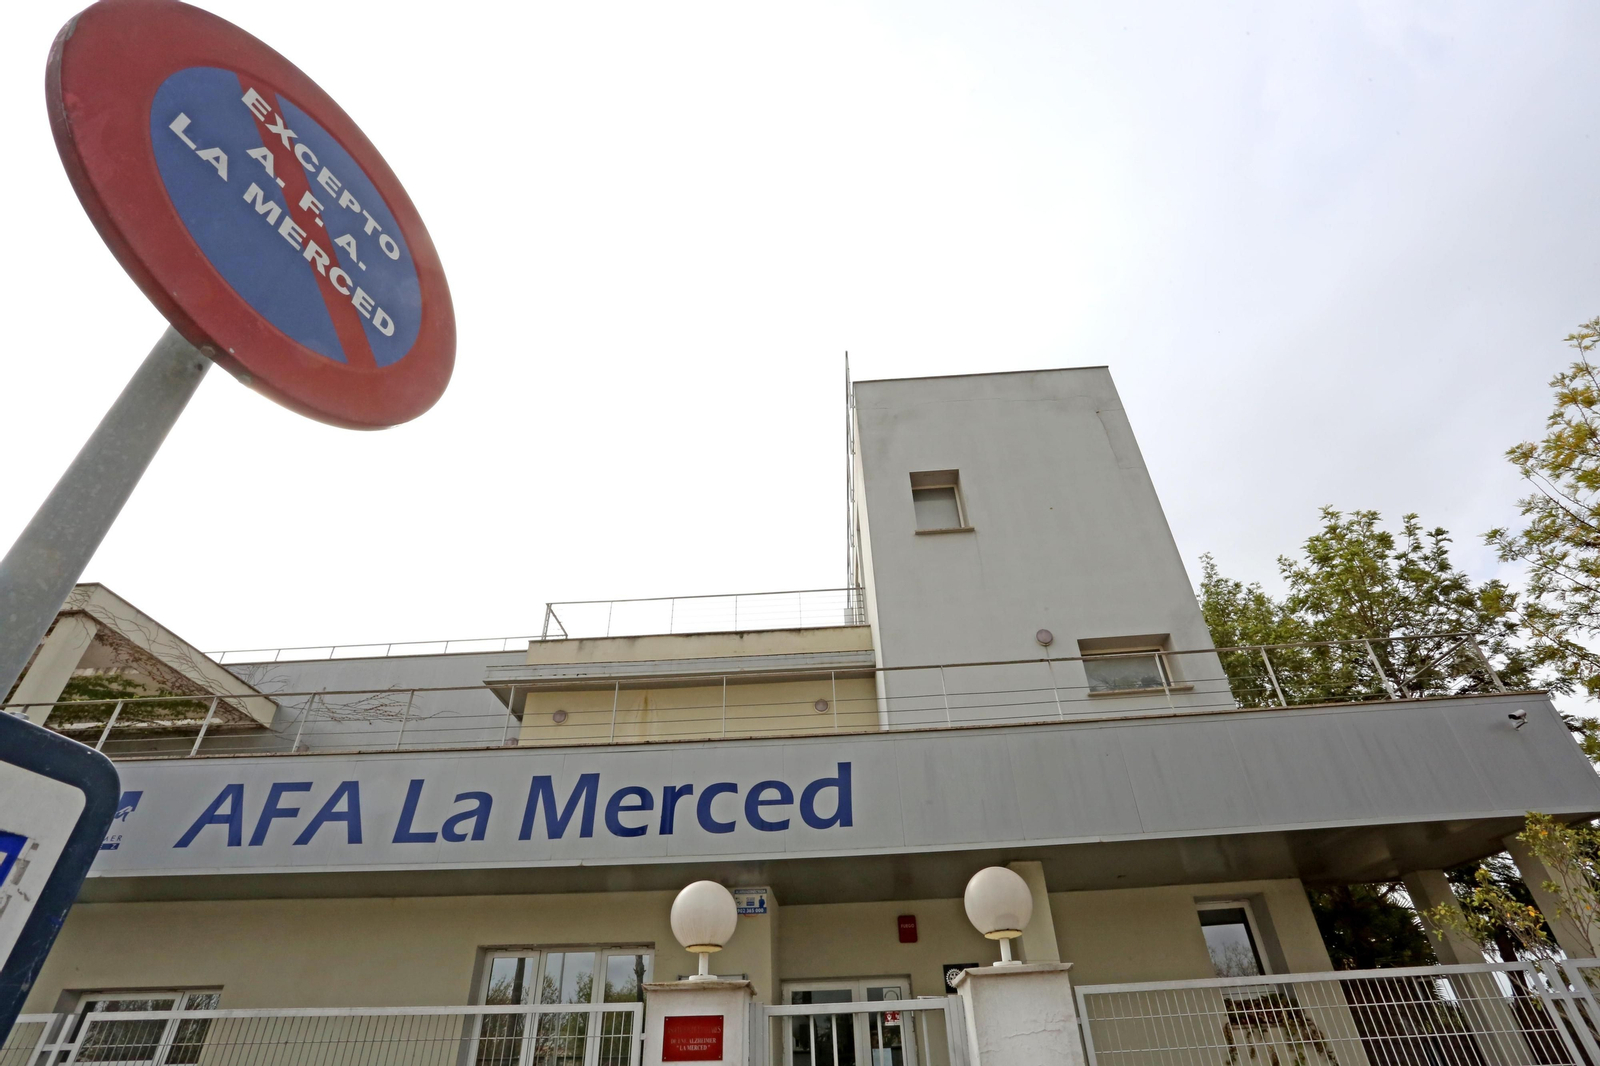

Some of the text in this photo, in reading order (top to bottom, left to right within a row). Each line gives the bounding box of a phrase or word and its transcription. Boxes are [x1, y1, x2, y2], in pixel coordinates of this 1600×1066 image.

[168, 112, 395, 337] LA MERCED
[241, 87, 400, 261] EXCEPTO
[172, 761, 853, 849] AFA La Merced
